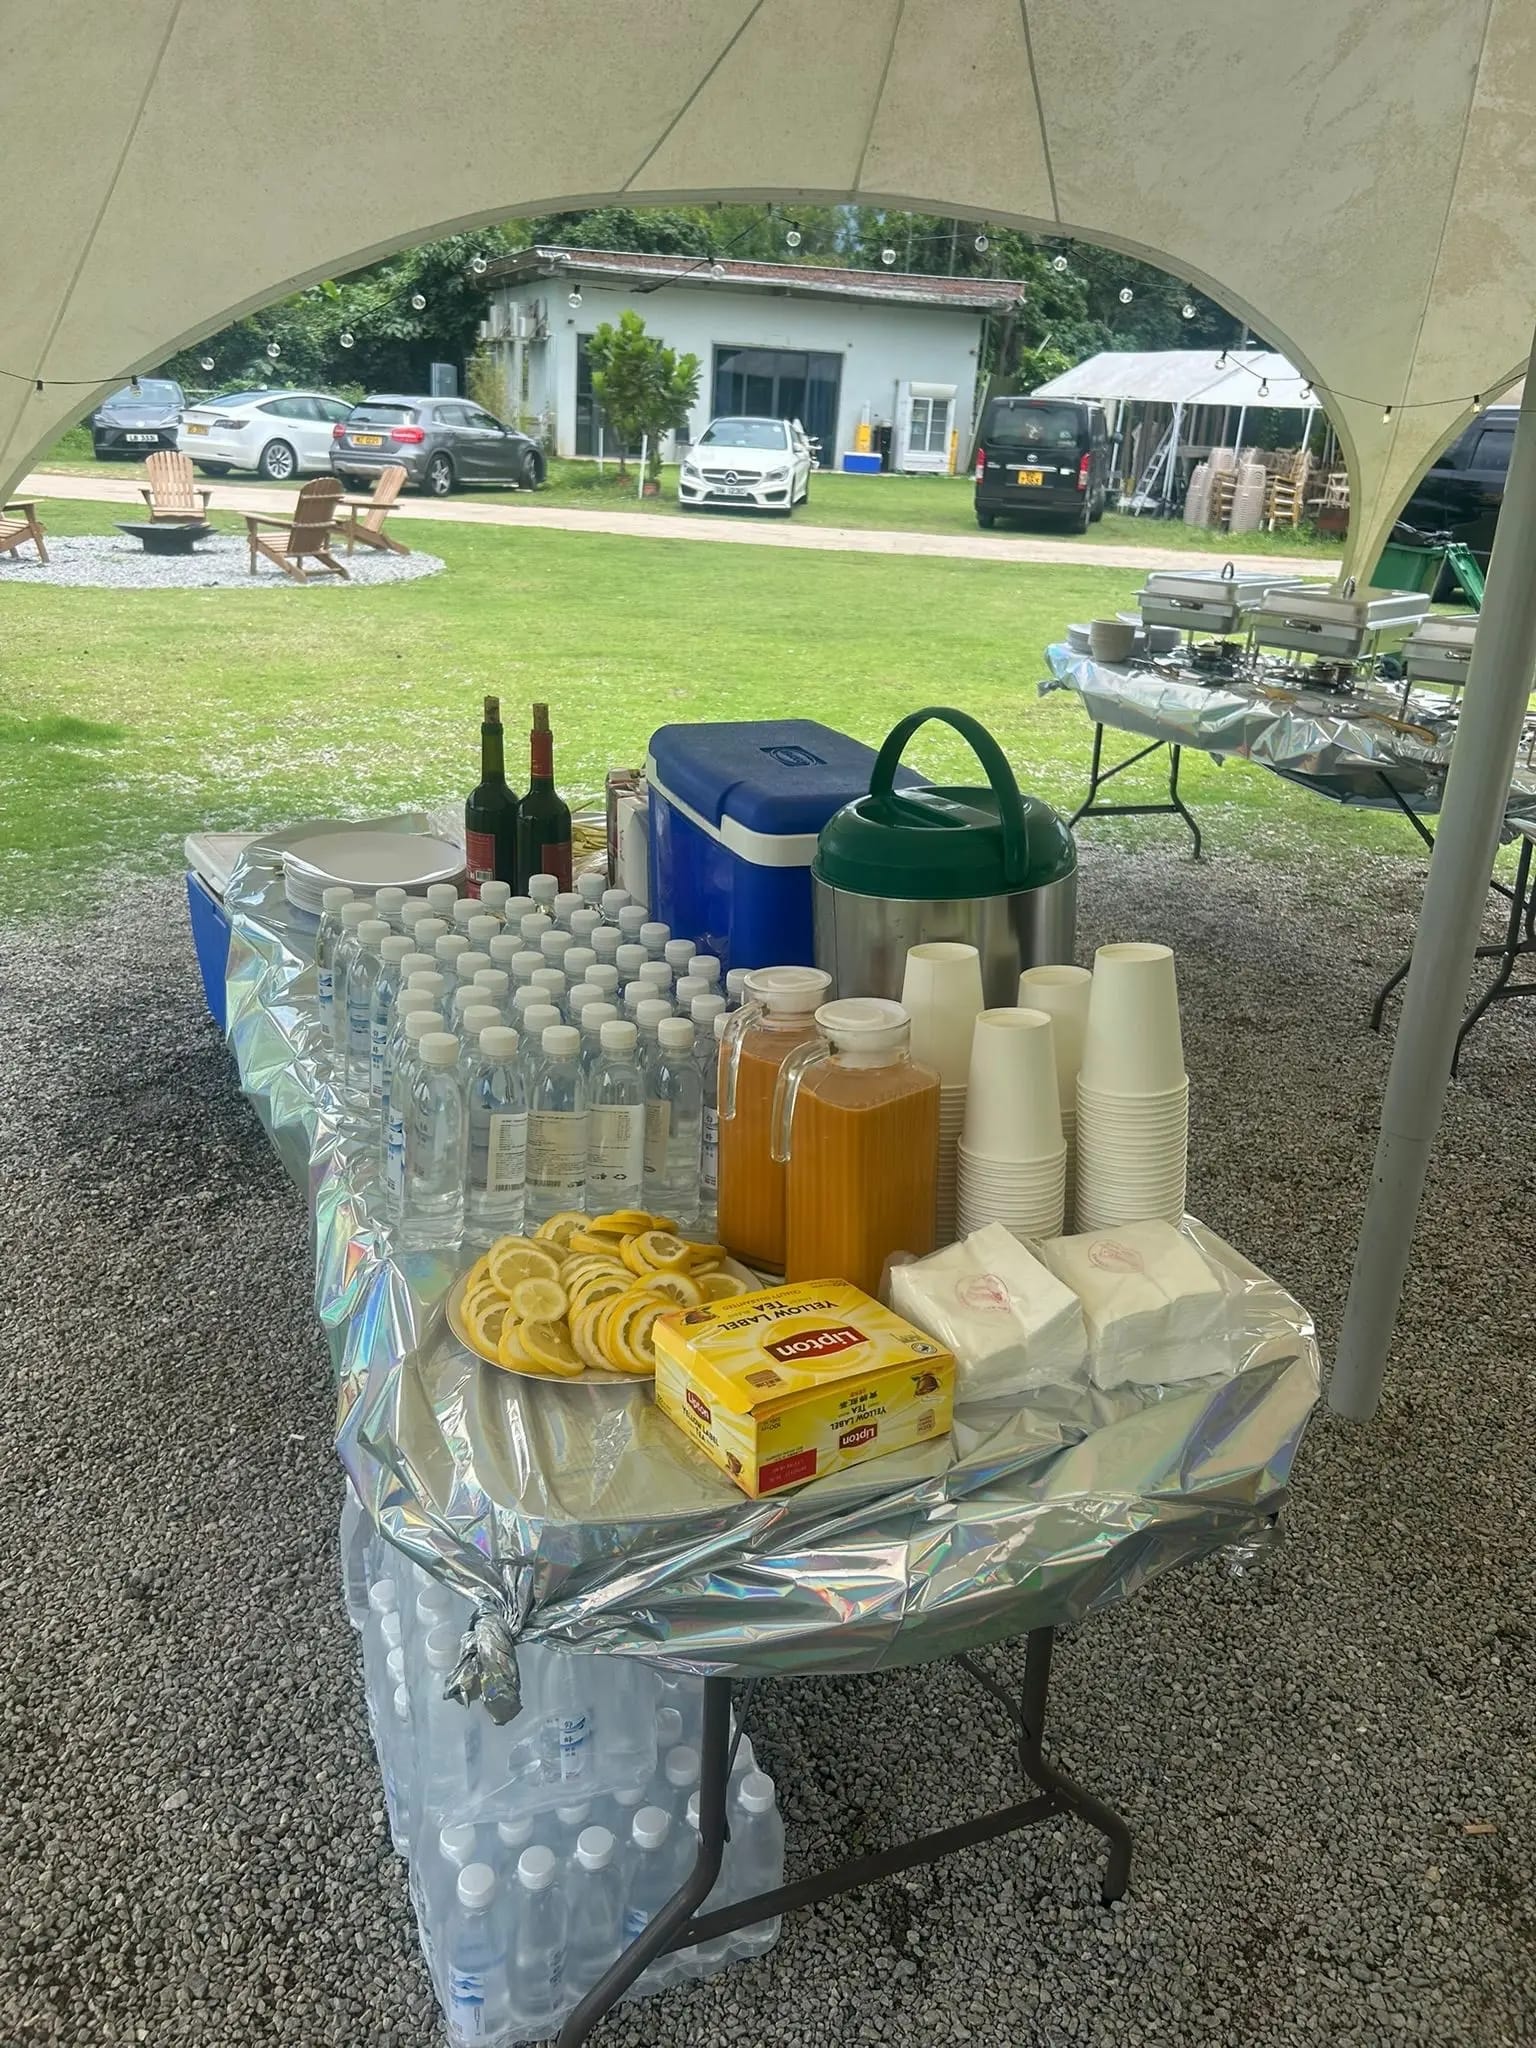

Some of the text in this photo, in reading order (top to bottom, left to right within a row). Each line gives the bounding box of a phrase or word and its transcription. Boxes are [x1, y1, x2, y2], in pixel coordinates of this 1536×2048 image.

[752, 1300, 789, 1311] TEA
[717, 1300, 838, 1331] YELLOW LABEL
[775, 1330, 859, 1357] Lipton
[687, 1391, 710, 1421] Lipton
[851, 1403, 866, 1414] TEA
[856, 1406, 887, 1422] YELLOW
[829, 1416, 854, 1431] LABEL
[702, 1425, 720, 1447] LABEL
[842, 1427, 875, 1446] Lipton
